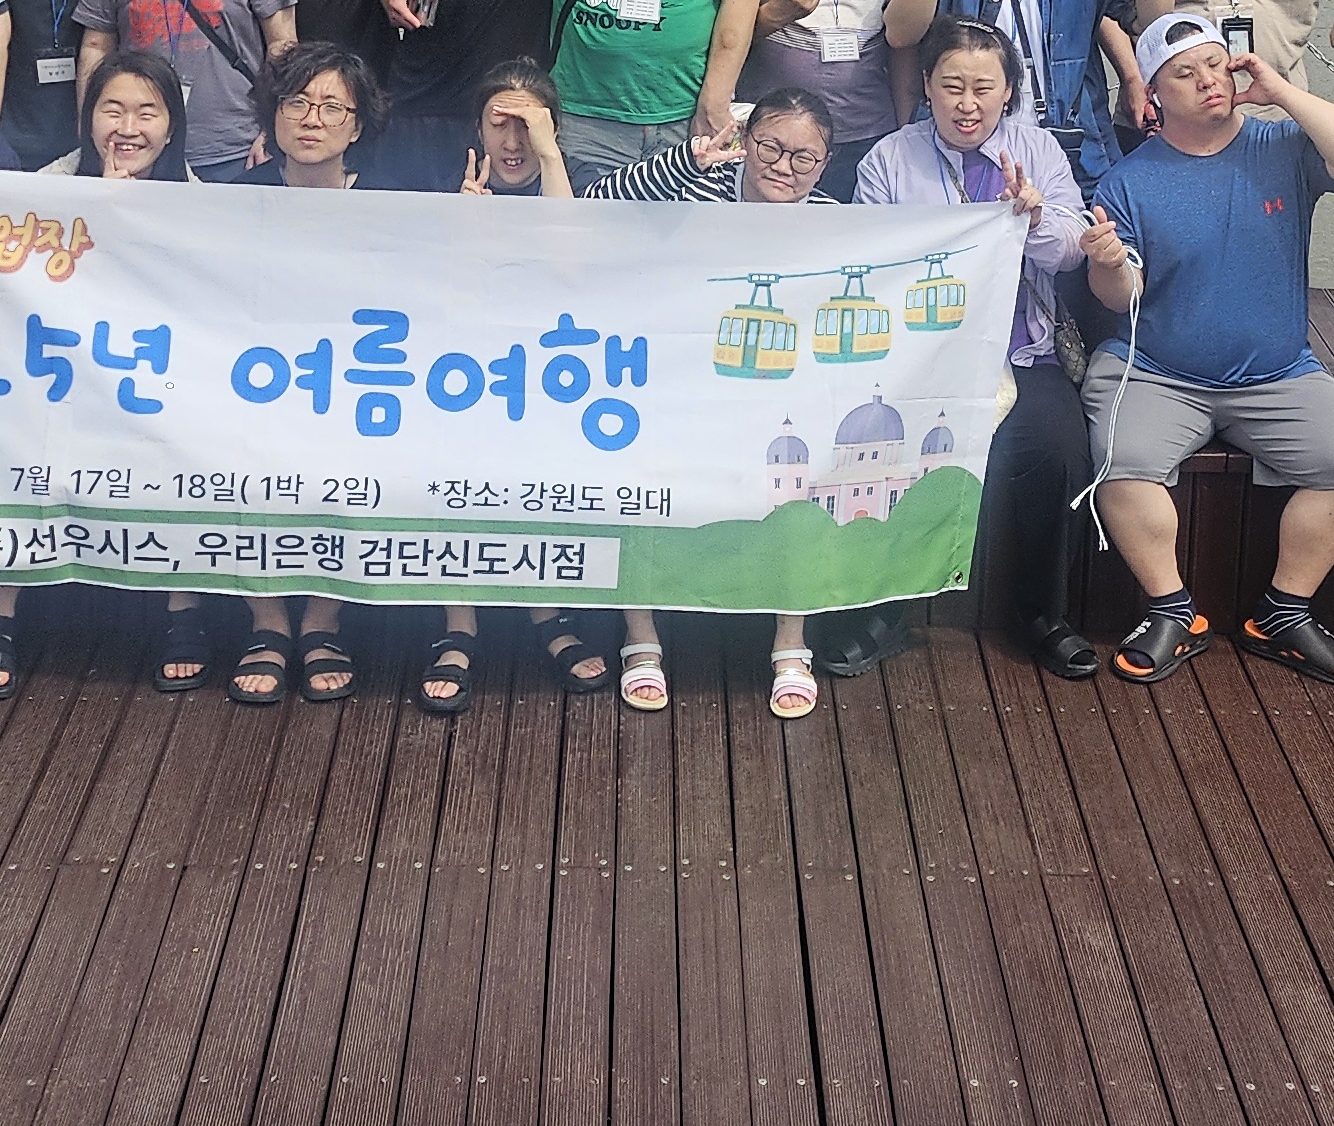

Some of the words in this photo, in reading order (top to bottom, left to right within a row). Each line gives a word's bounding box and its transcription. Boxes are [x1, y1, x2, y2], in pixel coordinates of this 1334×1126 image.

[230, 308, 649, 452] 여름여행
[10, 465, 52, 497] 7월
[70, 468, 132, 499] 17일
[321, 476, 381, 509] 2일)
[519, 481, 606, 514] 강원도
[615, 486, 672, 518] 일대
[193, 530, 346, 572] 우리은행
[357, 537, 588, 582] 검단신도시점
